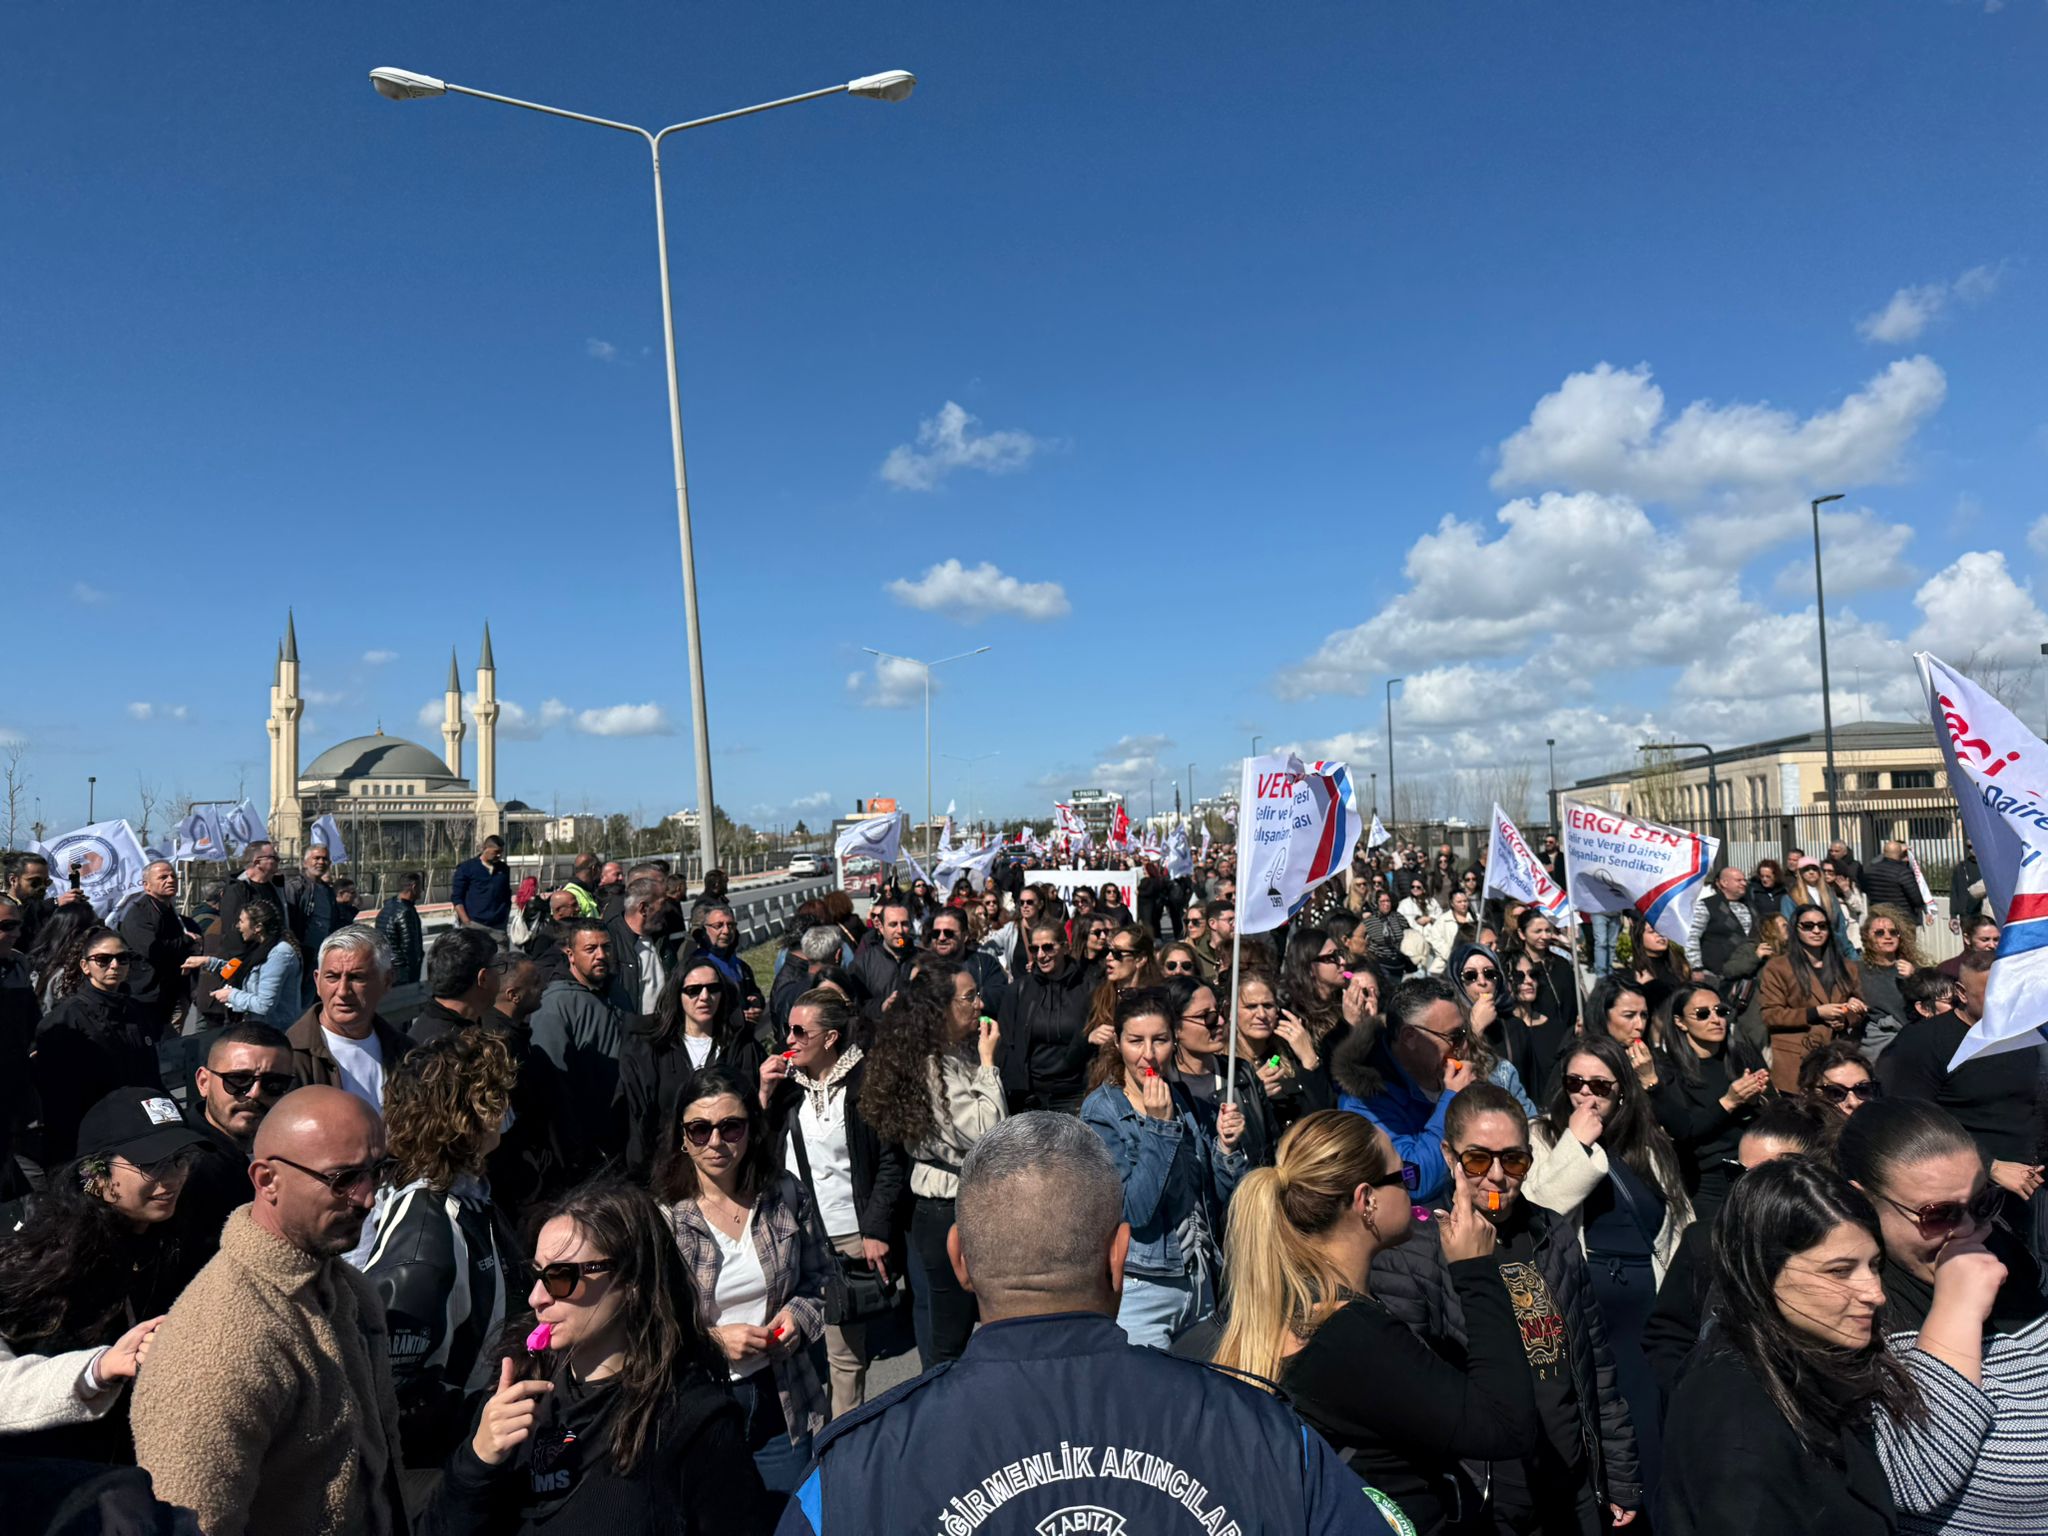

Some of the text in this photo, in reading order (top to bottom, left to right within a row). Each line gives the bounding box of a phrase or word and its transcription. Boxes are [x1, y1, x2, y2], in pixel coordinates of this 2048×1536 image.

[1583, 836, 1594, 847] ve
[1597, 838, 1626, 853] Vergi
[1628, 844, 1672, 862] Dairesi
[1608, 855, 1664, 875] Sendikası
[937, 1441, 1096, 1536] ĞİRMENLİK
